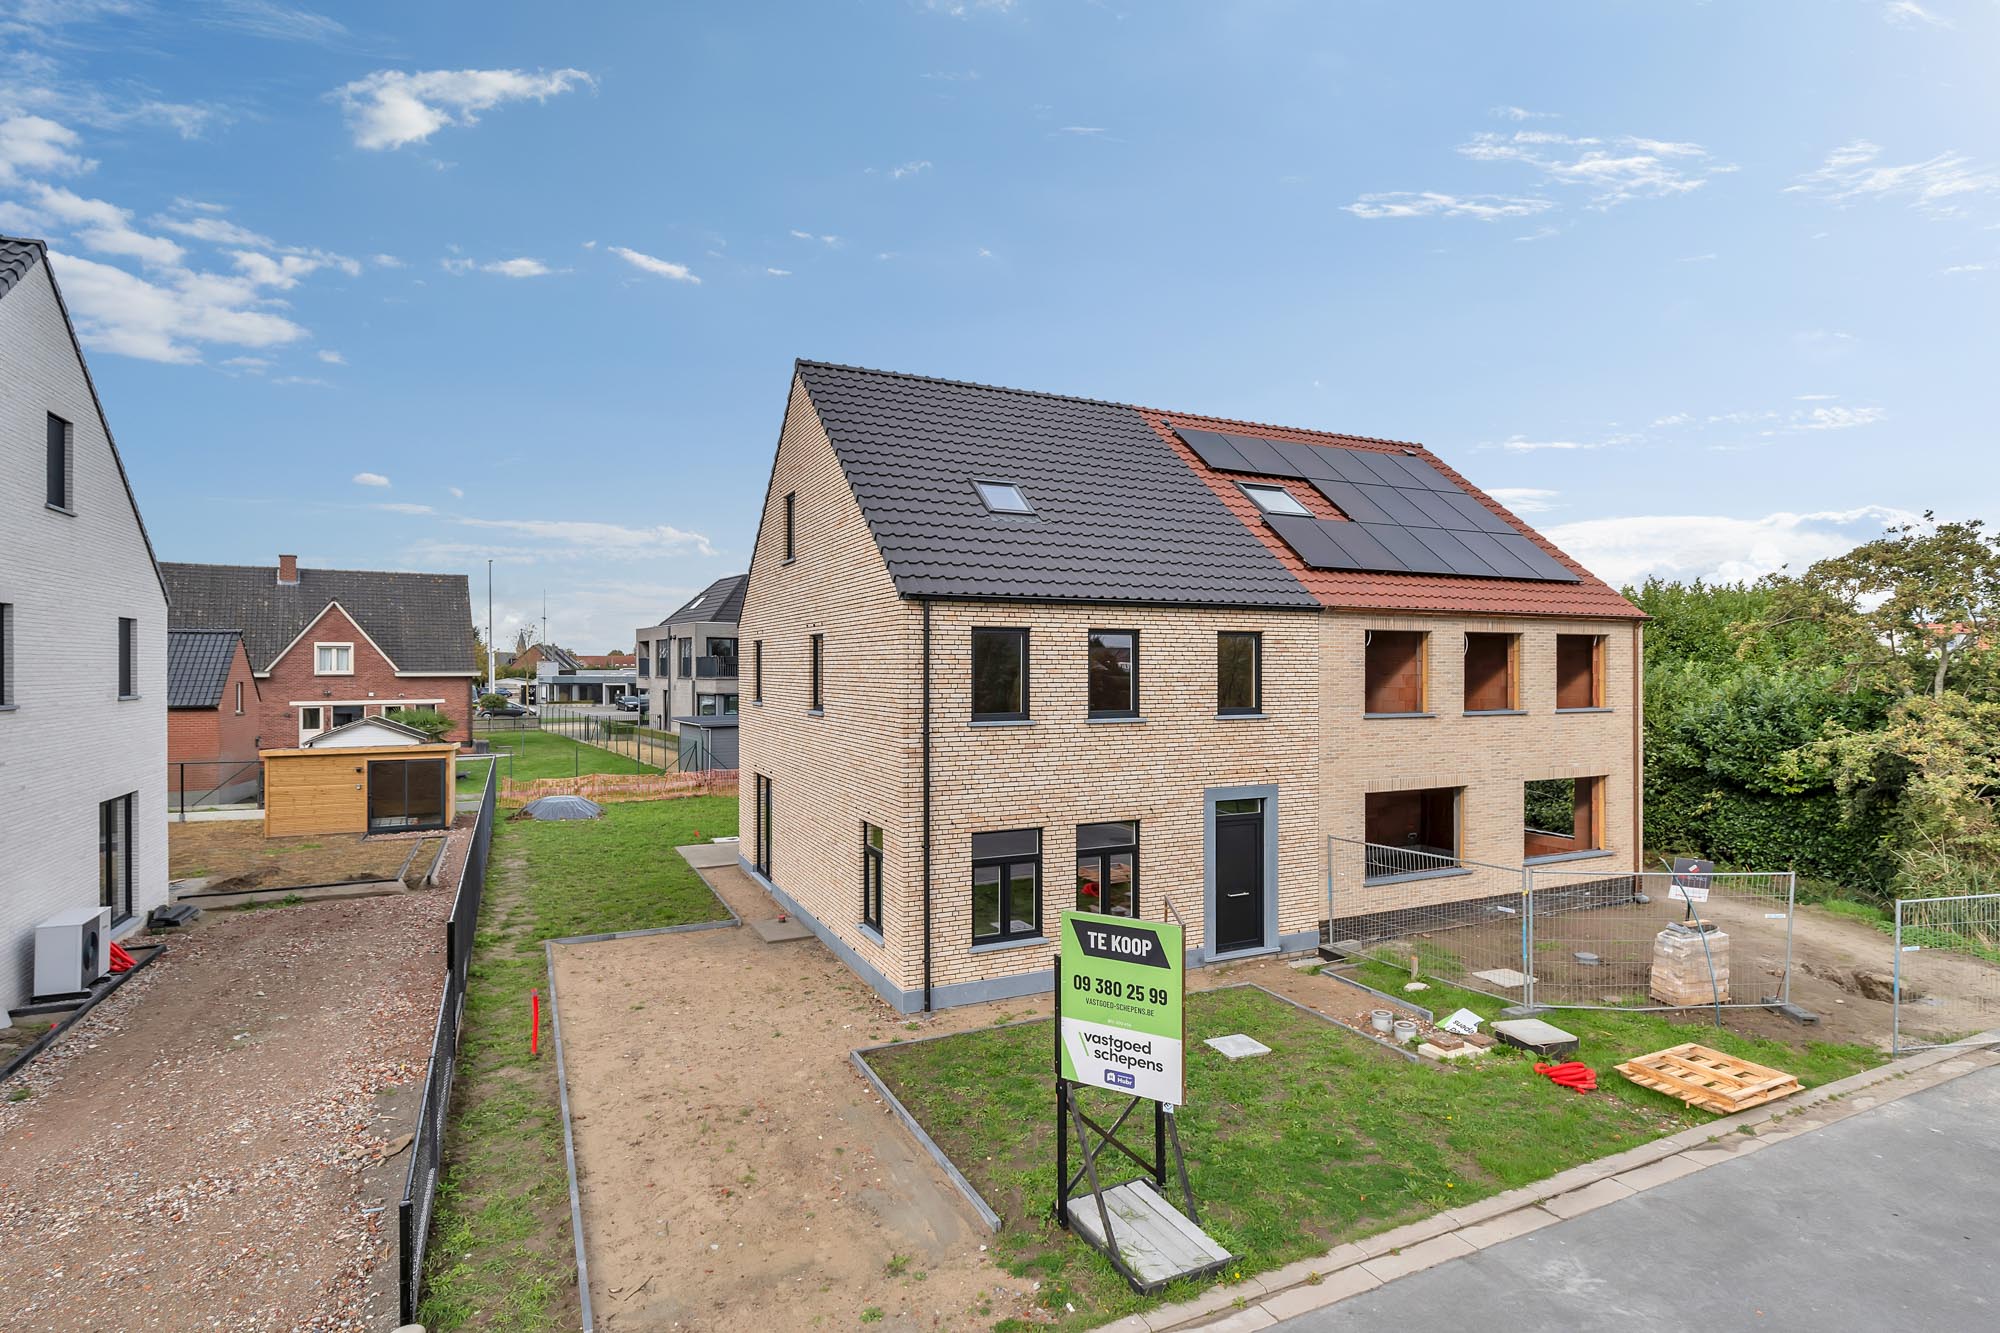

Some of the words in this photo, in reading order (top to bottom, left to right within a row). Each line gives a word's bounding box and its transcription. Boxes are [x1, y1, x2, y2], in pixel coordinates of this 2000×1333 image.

[1087, 931, 1107, 950] TE
[1111, 934, 1152, 957] KOOP
[1073, 974, 1091, 992] 09
[1095, 978, 1122, 998] 380
[1126, 983, 1145, 1002] 25
[1149, 987, 1168, 1006] 99
[1085, 997, 1155, 1017] VASTGOED-SCHEPENS.BE
[1084, 1032, 1152, 1055] vastgoed
[1094, 1048, 1163, 1072] schepens
